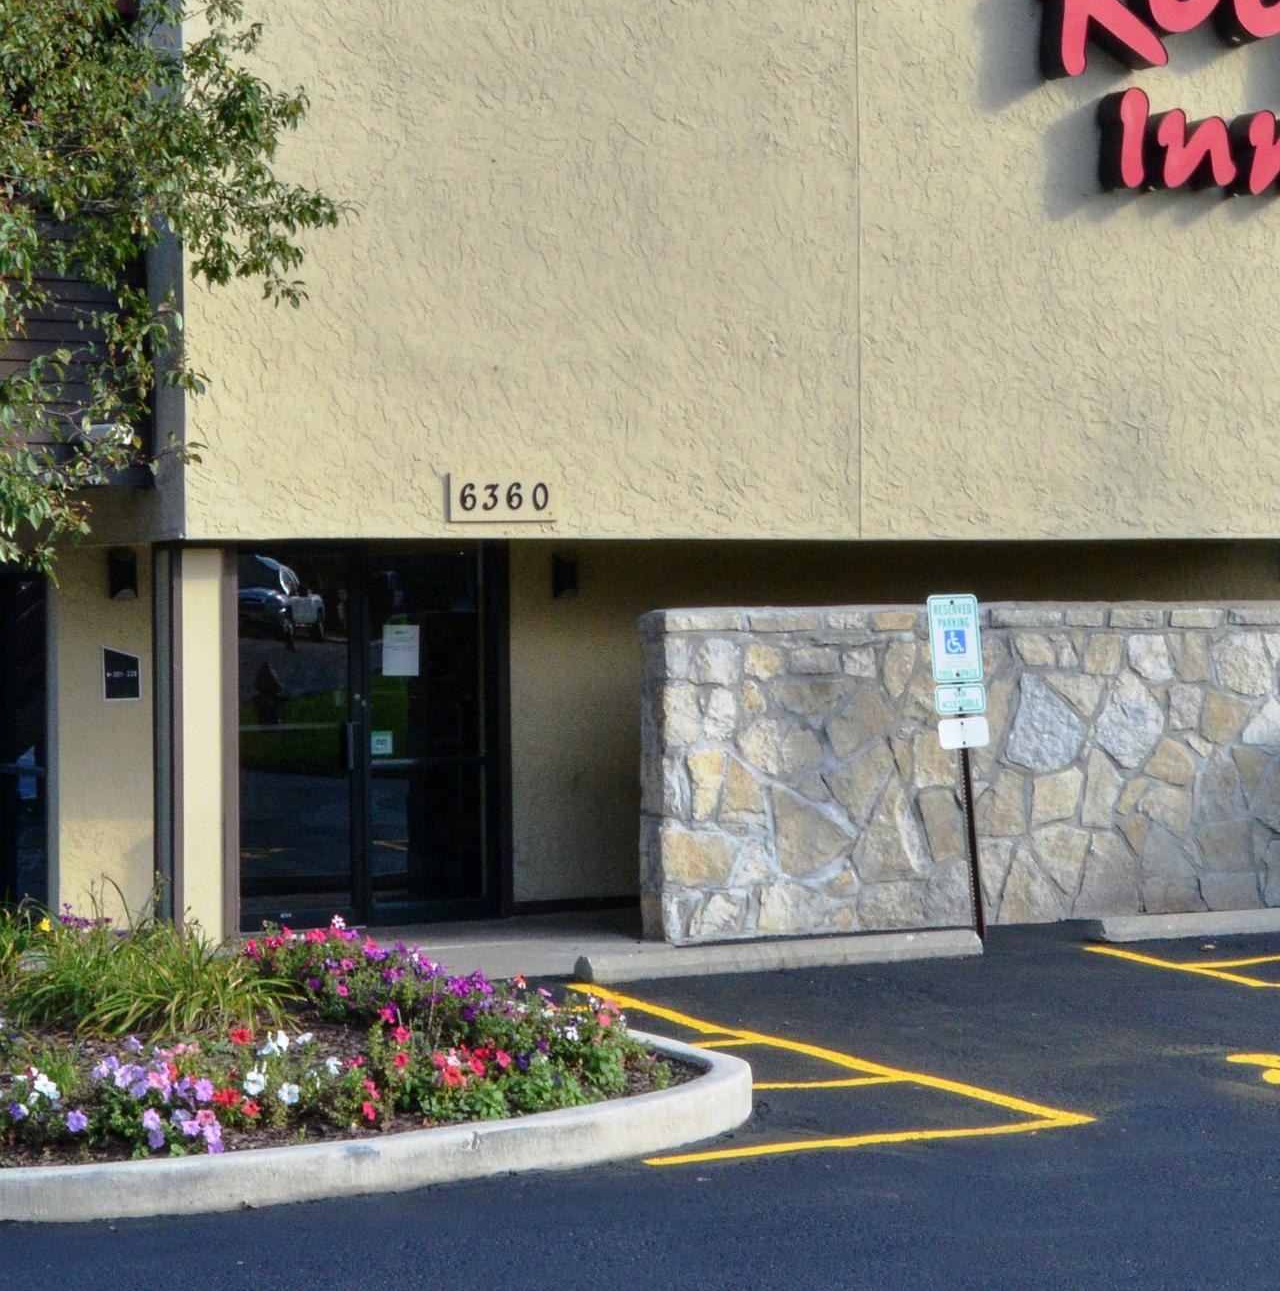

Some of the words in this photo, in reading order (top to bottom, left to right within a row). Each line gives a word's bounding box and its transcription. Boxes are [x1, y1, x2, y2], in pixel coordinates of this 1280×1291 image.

[459, 482, 549, 511] 6360
[932, 603, 972, 615] RESERVED
[937, 616, 969, 628] PARKING
